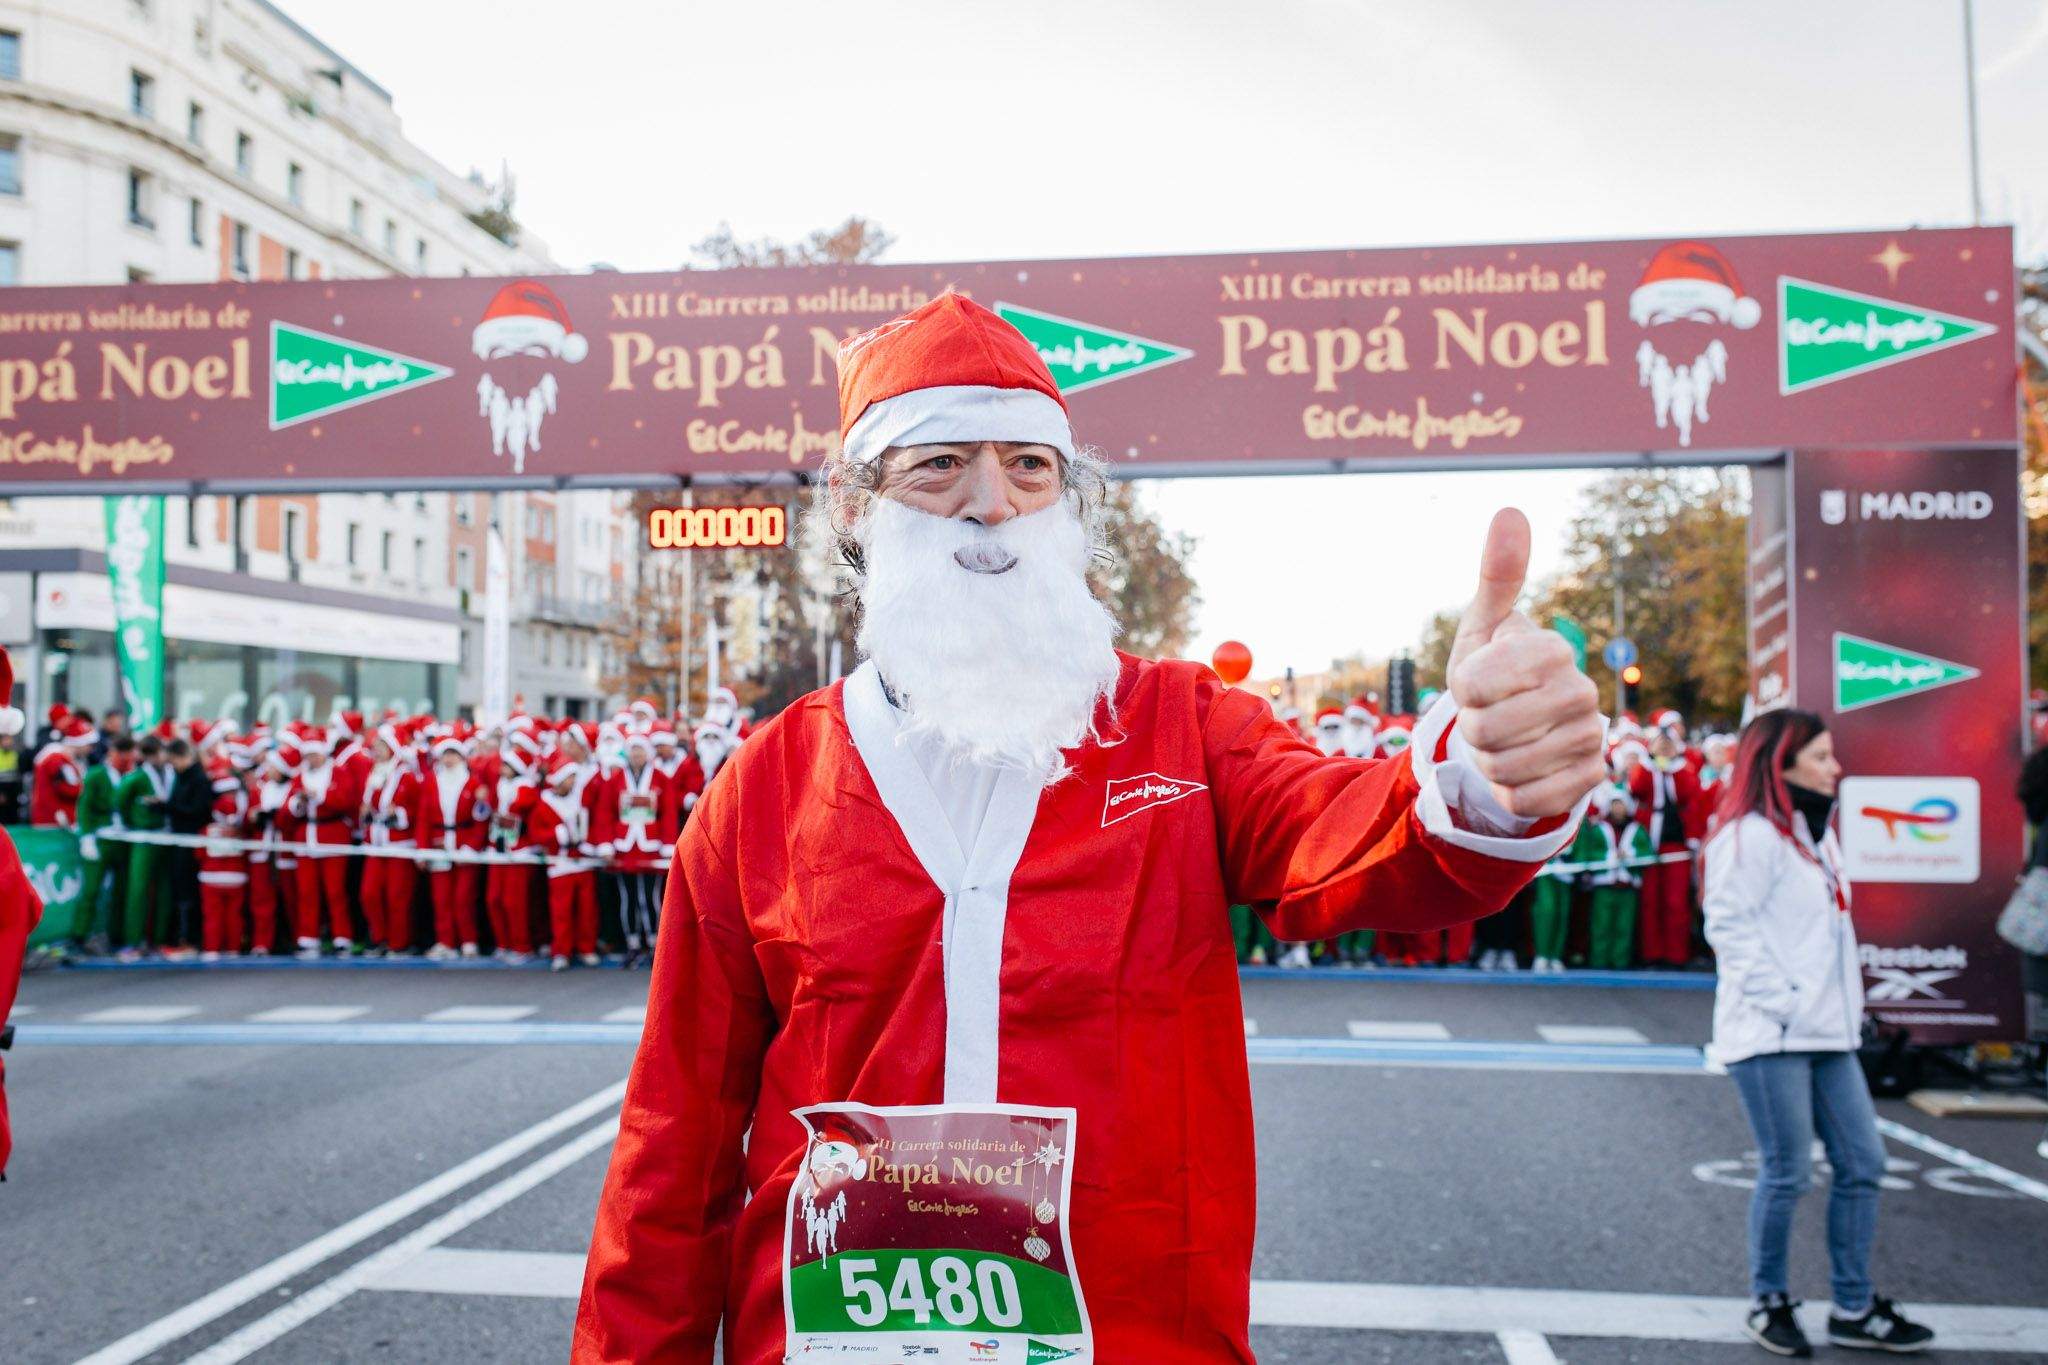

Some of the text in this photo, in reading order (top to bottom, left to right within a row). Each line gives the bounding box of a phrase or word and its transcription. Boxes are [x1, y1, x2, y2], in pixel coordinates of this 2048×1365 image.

[1220, 262, 1606, 301] XIII Carrera solidaria de
[0, 301, 250, 332] arrera solidaria de
[612, 293, 669, 319] XIII
[677, 292, 789, 317] Carrera
[1217, 299, 1609, 393] Papá Noel
[0, 336, 252, 419] pá Noel
[608, 324, 786, 408] Papá
[1861, 490, 1994, 520] MADRID
[650, 507, 785, 548] 000000
[898, 1139, 945, 1153] Carrera
[947, 1138, 1006, 1153] solidaria
[1009, 1140, 1026, 1153] de
[866, 1154, 1025, 1193] Papá Noel
[839, 1256, 1023, 1328] 5480
